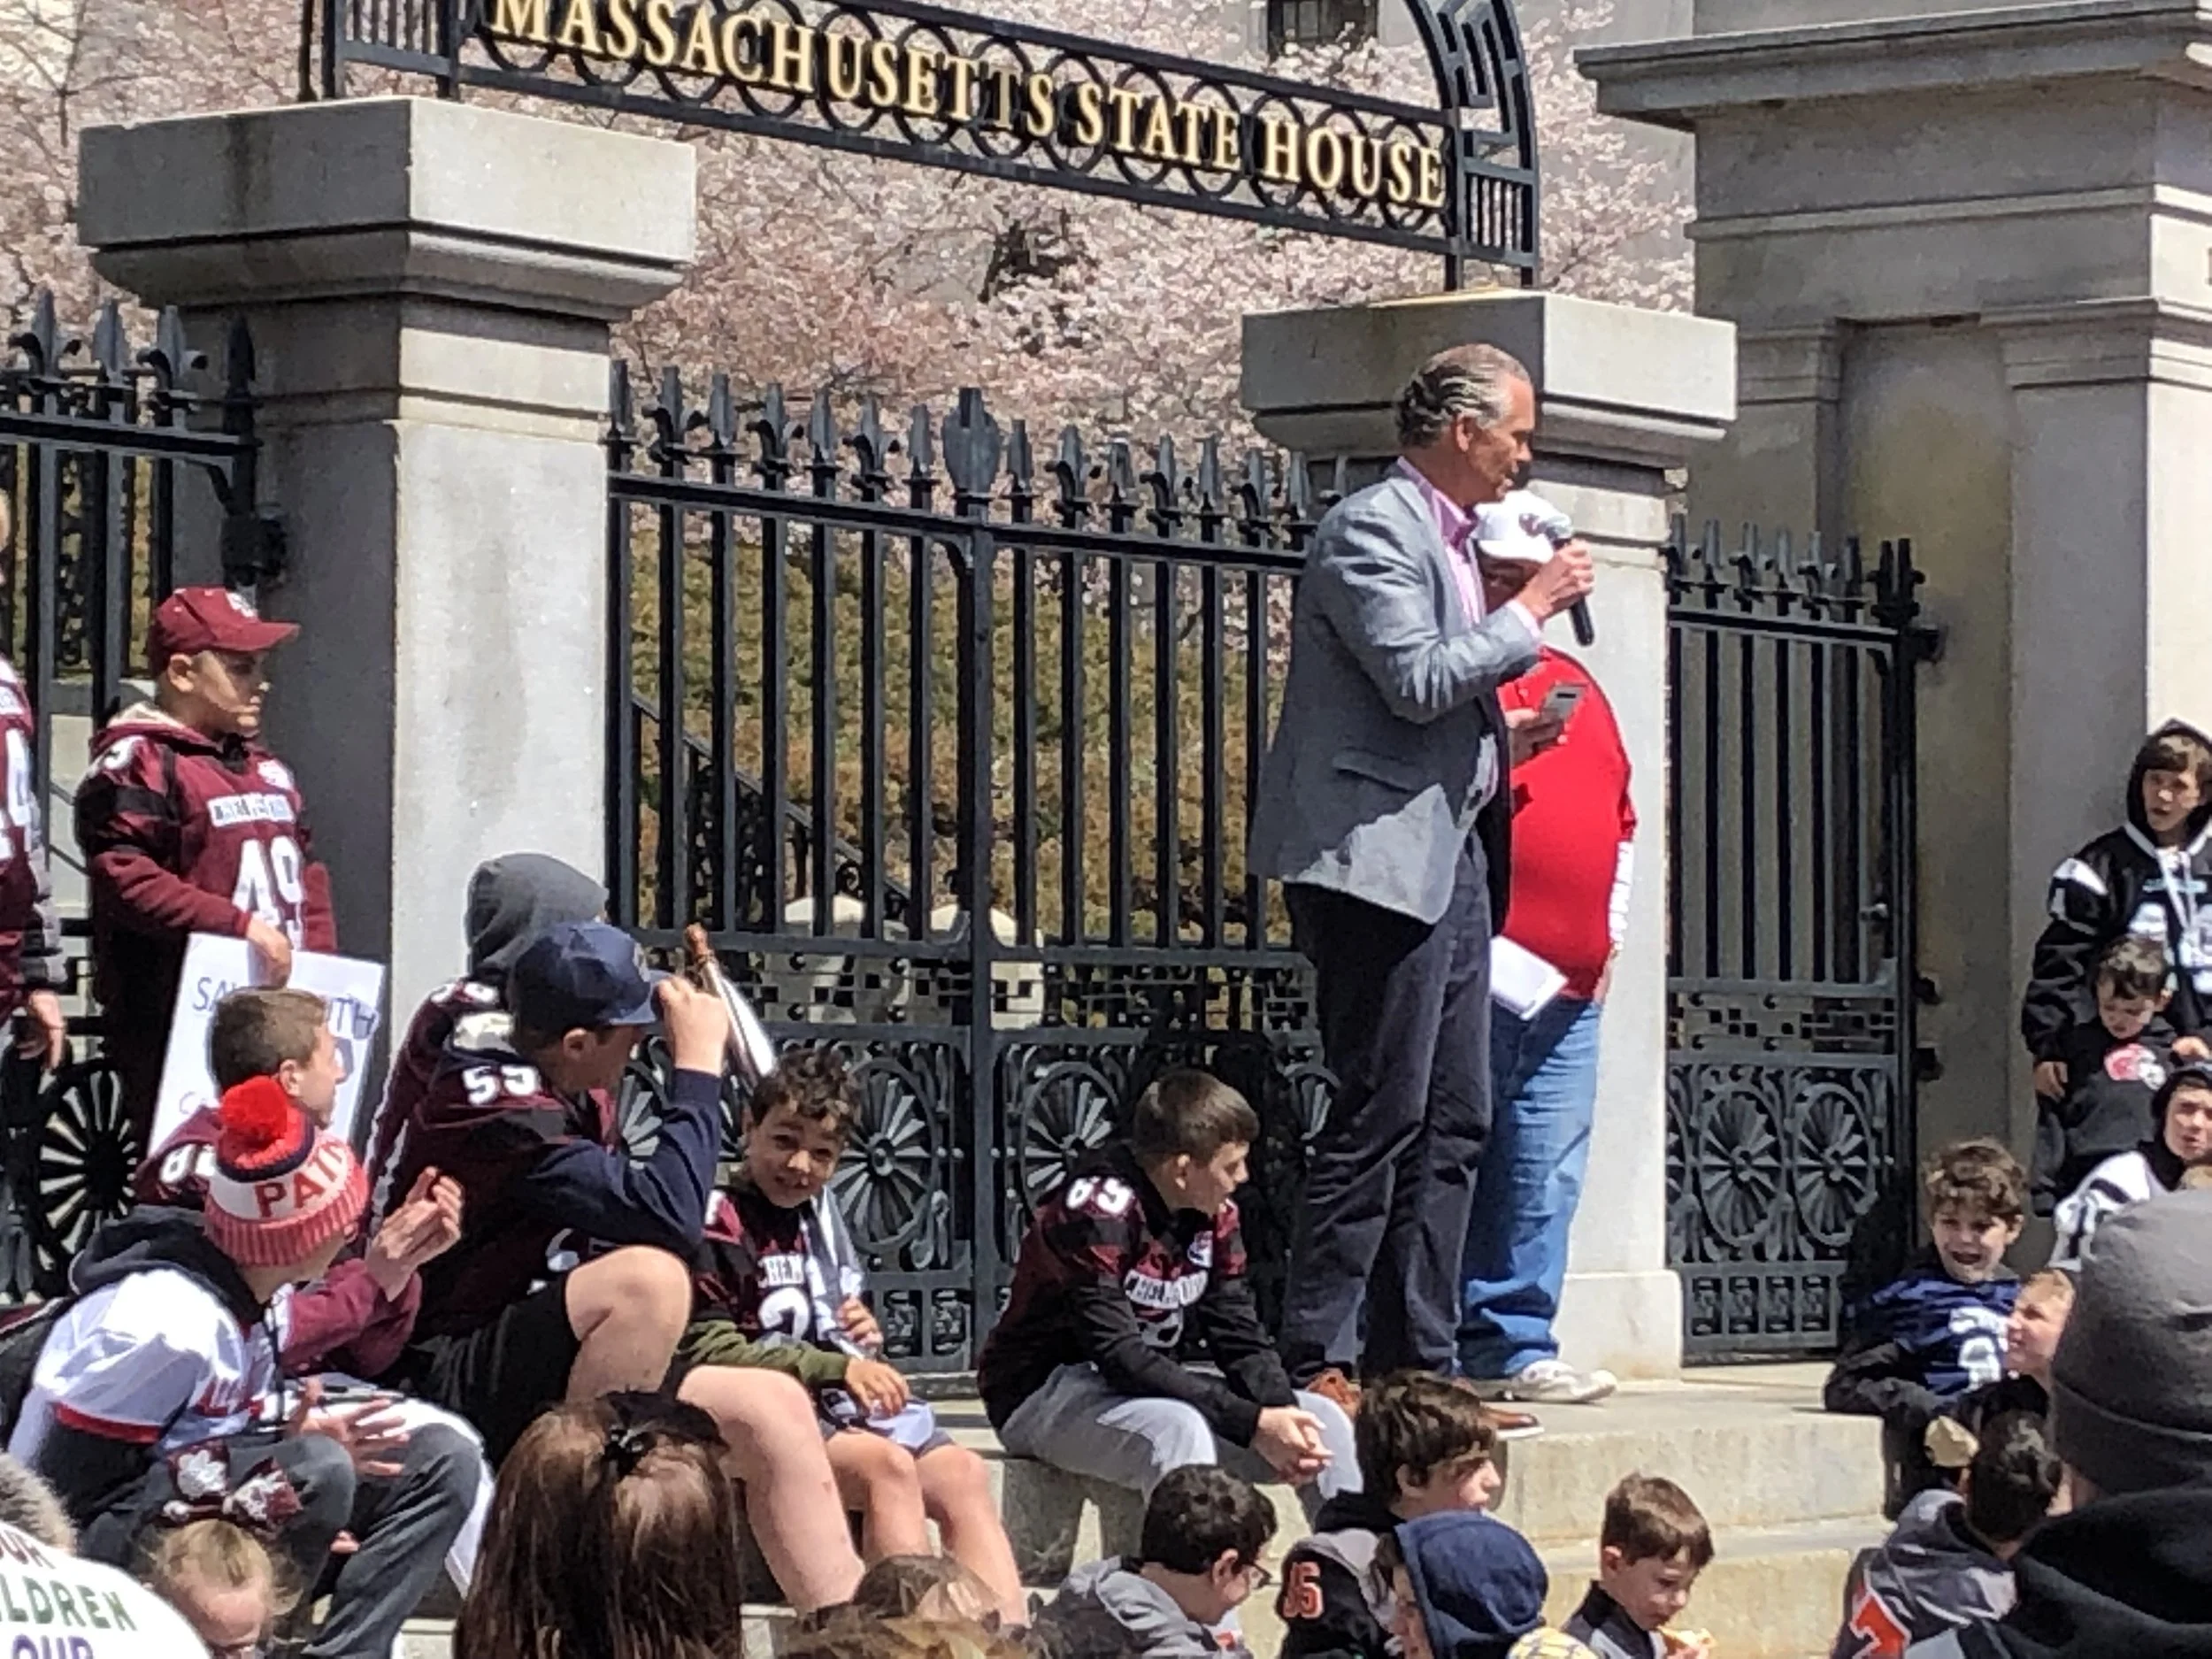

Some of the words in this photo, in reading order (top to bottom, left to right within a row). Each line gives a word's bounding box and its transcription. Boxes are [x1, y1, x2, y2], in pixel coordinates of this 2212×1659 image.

[491, 0, 1054, 137] MASSACHUSETTS
[1077, 81, 1240, 170] STATE
[1264, 118, 1447, 209] HOUSE
